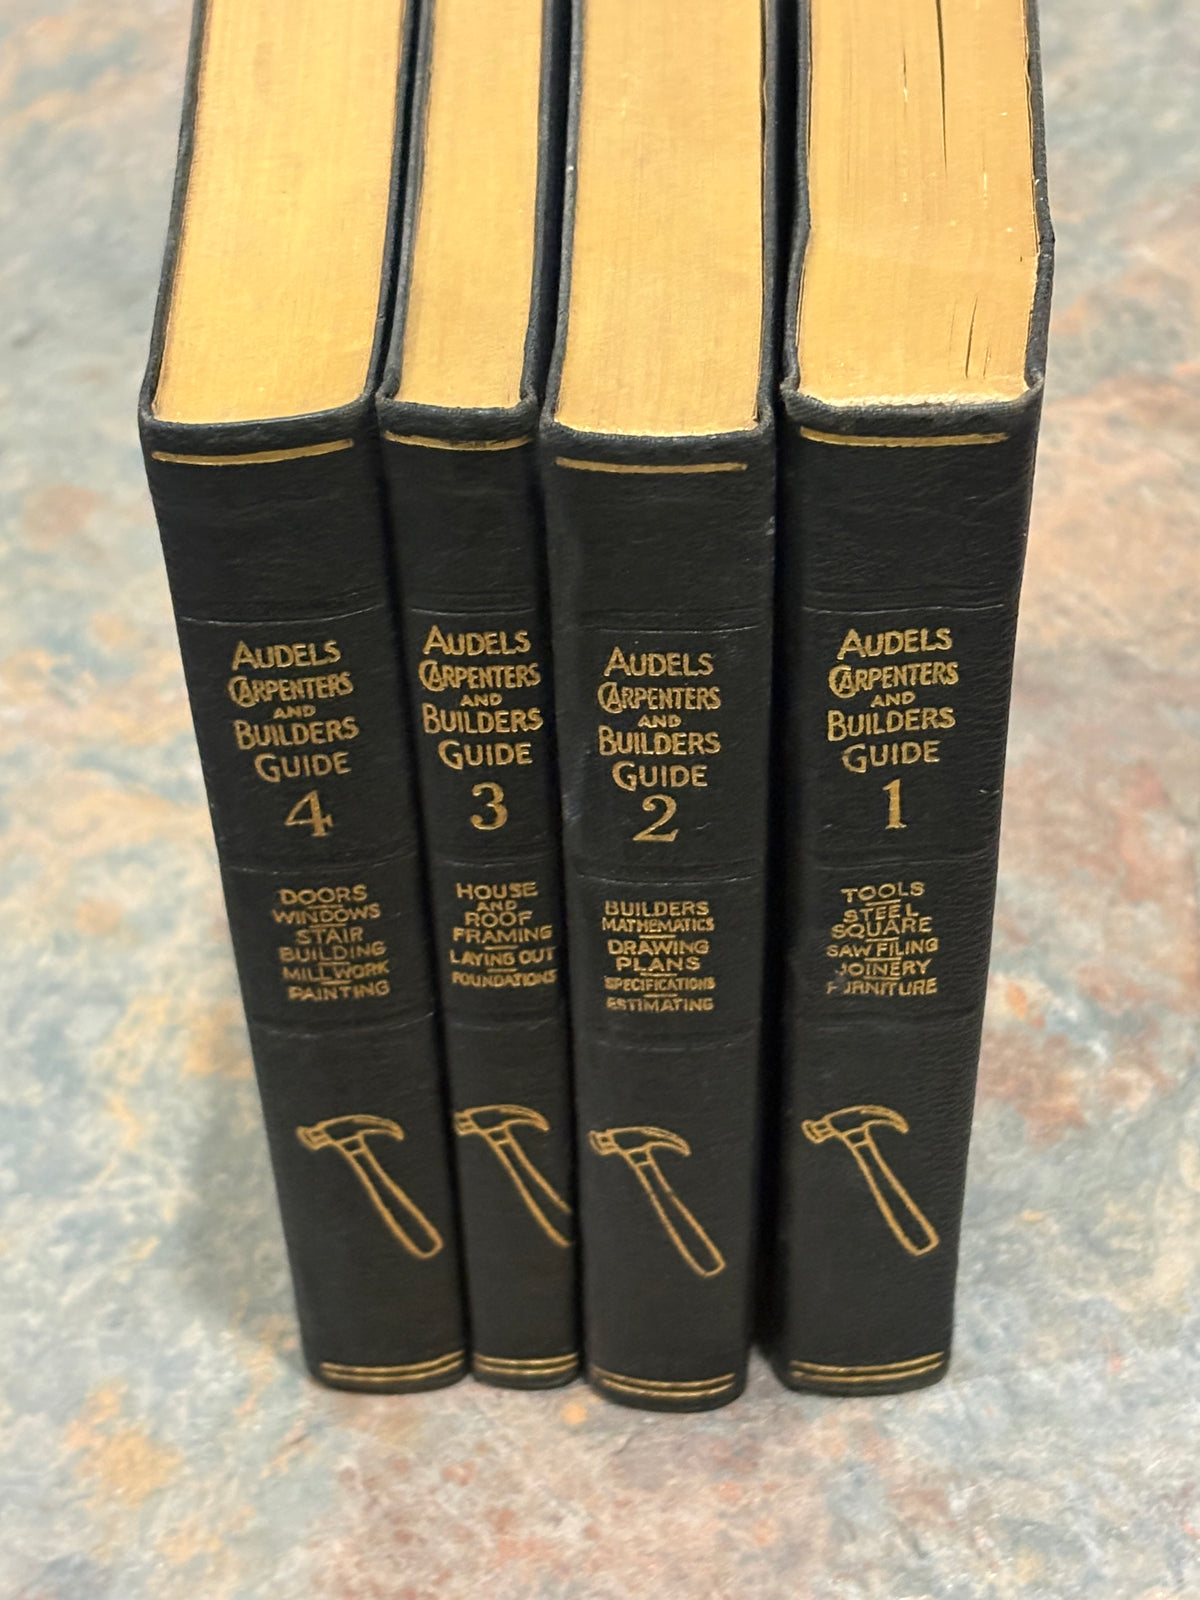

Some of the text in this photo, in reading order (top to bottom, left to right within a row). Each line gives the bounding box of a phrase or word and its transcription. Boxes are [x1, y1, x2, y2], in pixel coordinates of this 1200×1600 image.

[423, 625, 531, 656] AUDELS
[836, 628, 953, 660] AUDELS
[232, 640, 341, 671] AUDELS
[603, 646, 714, 677] AUDELS
[418, 659, 541, 692] CARPENTERS
[828, 661, 960, 698] CARPENTERS
[228, 671, 354, 708] CARPENTERS
[460, 693, 503, 707] AND
[597, 682, 721, 714] CARPENTERS
[870, 691, 916, 707] AND
[273, 704, 317, 719] AND
[422, 703, 544, 734] BUILDERS
[637, 714, 682, 729] AND
[233, 716, 360, 750] BUILDERS
[827, 707, 956, 741] BUILDERS
[598, 725, 722, 756] BUILDERS
[437, 739, 533, 770] GUIDE
[841, 740, 940, 773] GUIDE
[254, 751, 351, 783] GUIDE
[612, 761, 708, 792] GUIDE
[284, 789, 334, 837] 4
[470, 782, 508, 830] 3
[882, 778, 908, 829] 1
[632, 794, 679, 842] 2
[279, 884, 368, 905] DOORS
[456, 882, 538, 900] HOUSE
[840, 881, 926, 903] TOOLS
[272, 903, 381, 924] WINDOWS
[477, 900, 518, 912] AND
[604, 900, 710, 917] BUILDERS
[843, 903, 920, 923] STEEL
[464, 911, 533, 928] ROOF
[601, 917, 715, 933] MATHEMATICS
[831, 916, 933, 939] SQUARE
[296, 926, 363, 945] STAIR
[453, 925, 552, 944] FRAMING
[279, 941, 388, 962] BUILDING
[449, 946, 556, 967] LAYING OUT
[607, 939, 710, 956] DRAWING
[826, 937, 939, 958] SAW FILING
[615, 957, 701, 972] PLANS
[835, 958, 932, 977] JOINERY
[451, 969, 558, 988] FOUNDATIONS
[604, 976, 716, 992] SPECIFICATIONS
[288, 980, 390, 1001] PAINTING
[606, 996, 714, 1013] ESTIMATING
